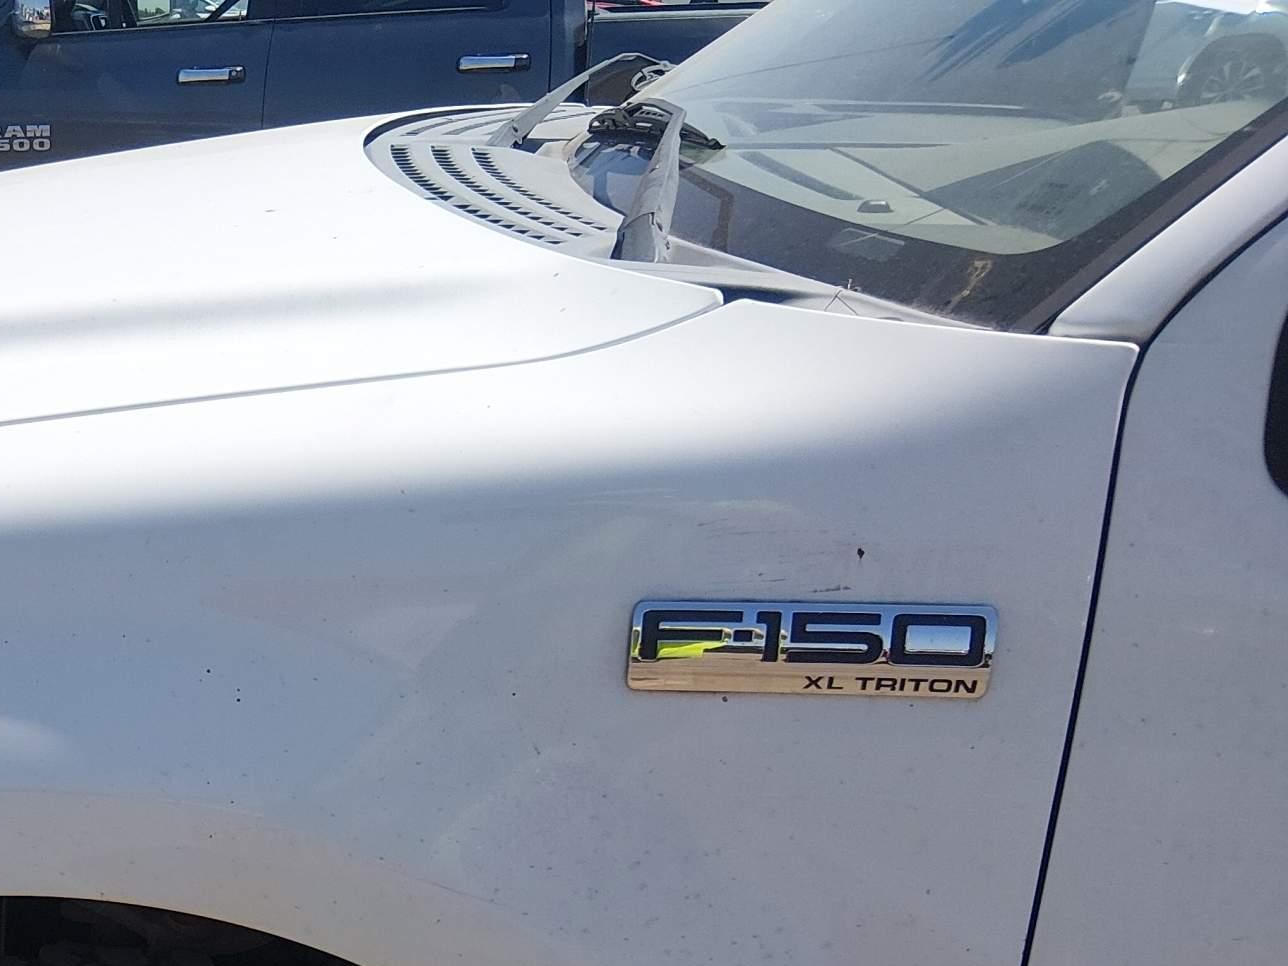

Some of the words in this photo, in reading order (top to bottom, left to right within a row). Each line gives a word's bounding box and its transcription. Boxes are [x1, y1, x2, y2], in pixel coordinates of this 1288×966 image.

[638, 609, 987, 667] F-150
[802, 675, 844, 690] XL
[855, 676, 978, 694] TRITON
